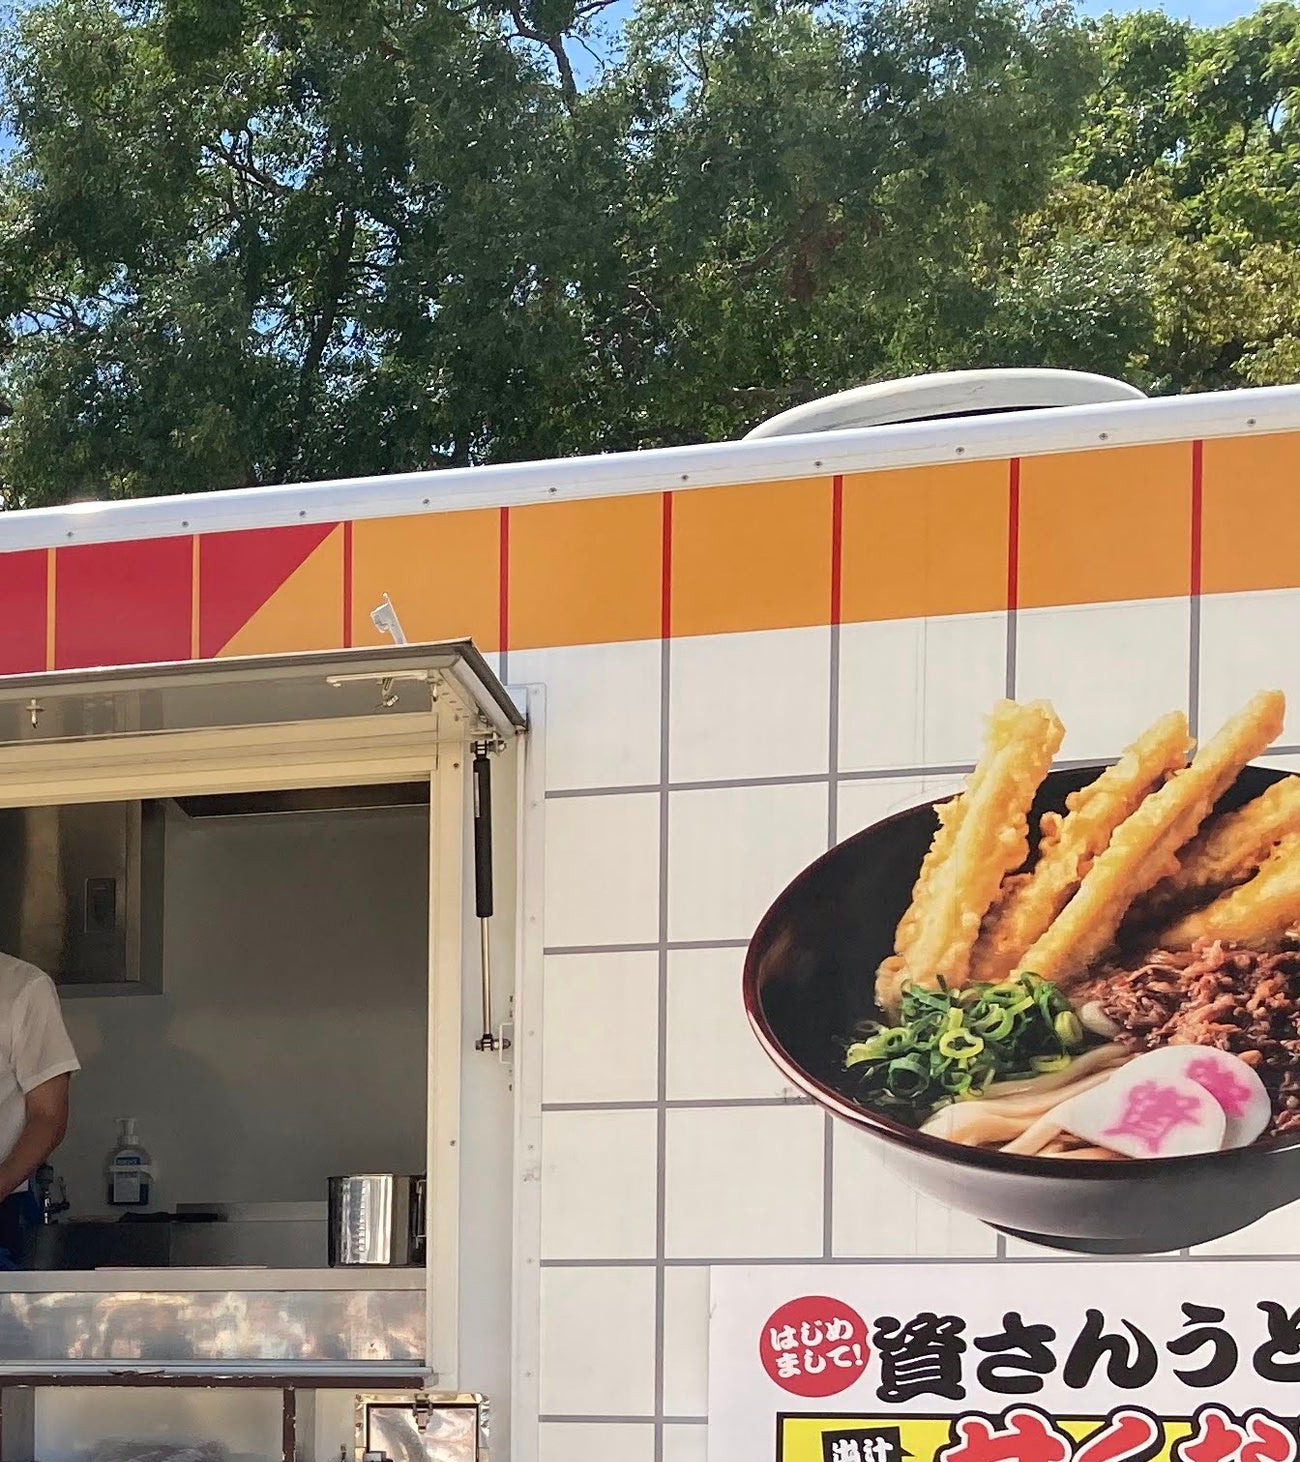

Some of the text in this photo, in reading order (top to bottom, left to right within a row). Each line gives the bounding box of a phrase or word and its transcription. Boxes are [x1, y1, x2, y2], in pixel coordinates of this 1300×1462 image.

[769, 1317, 854, 1352] はじめ
[776, 1343, 864, 1379] まして!
[872, 1303, 1300, 1403] 資さんうど
